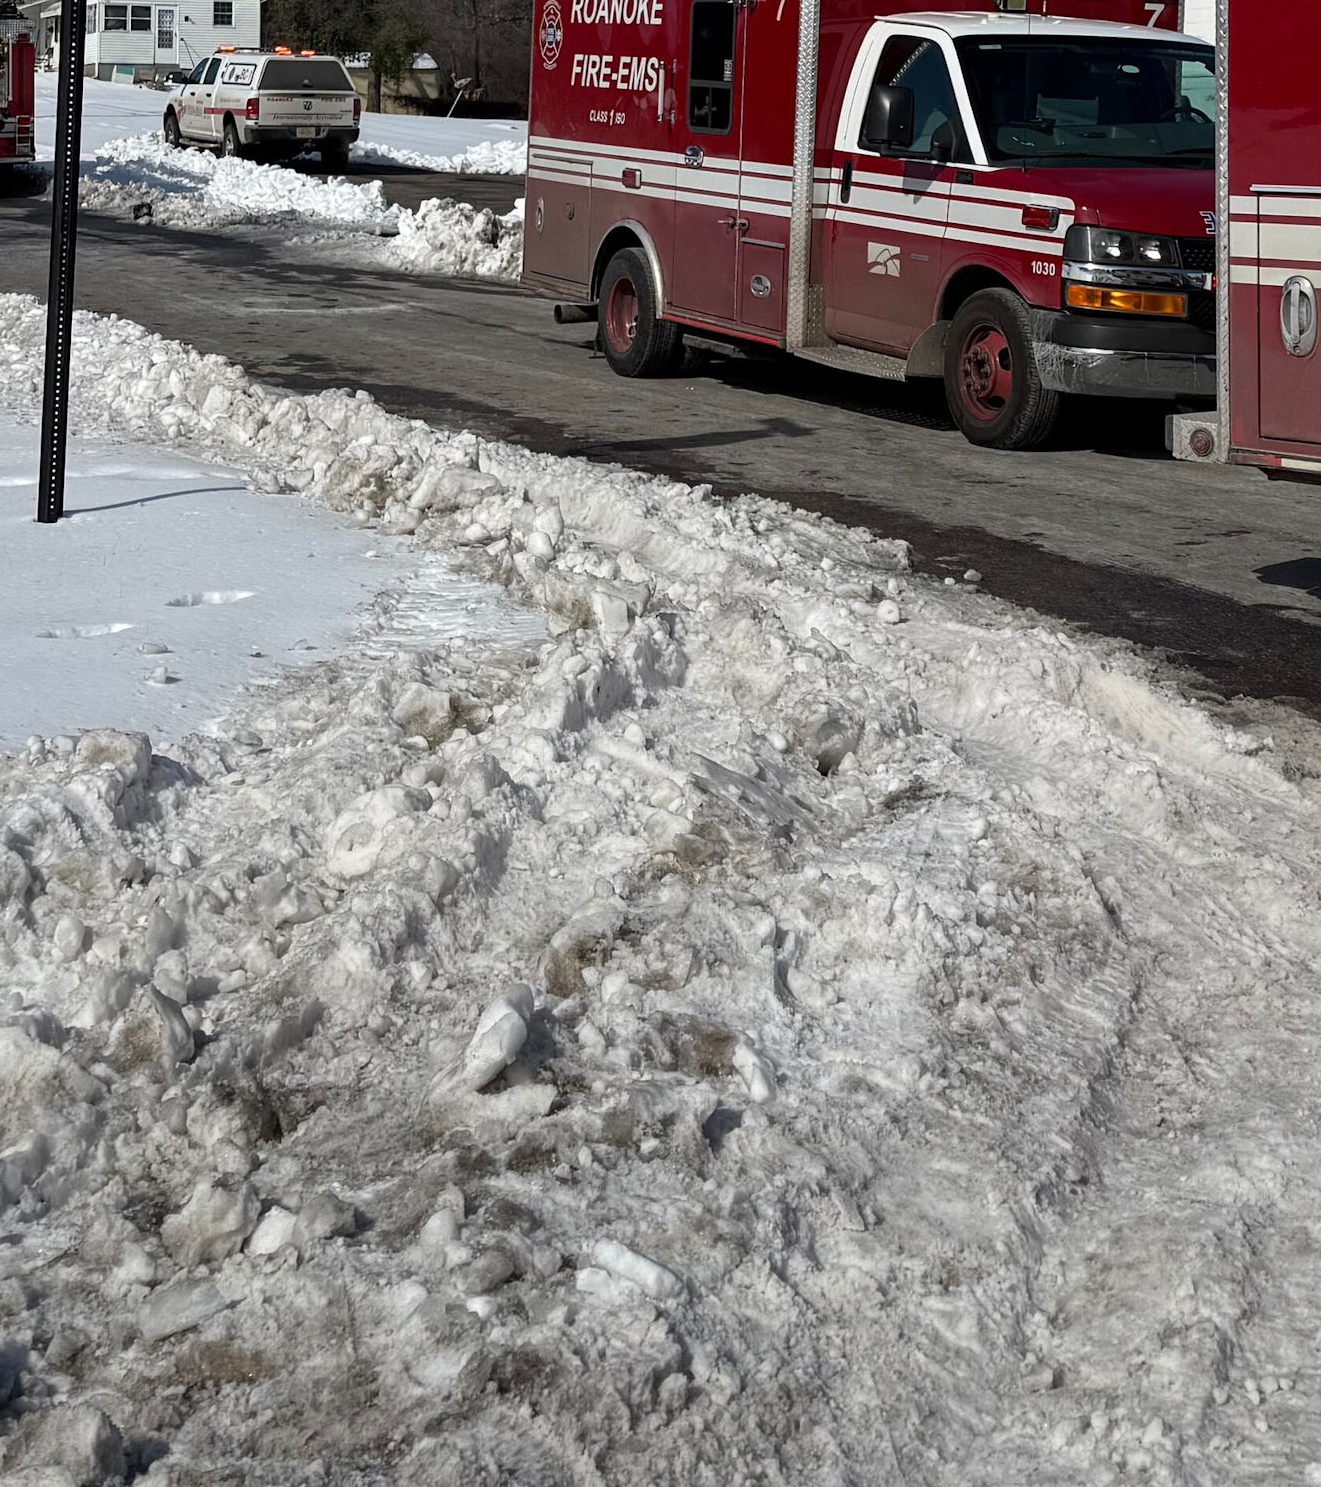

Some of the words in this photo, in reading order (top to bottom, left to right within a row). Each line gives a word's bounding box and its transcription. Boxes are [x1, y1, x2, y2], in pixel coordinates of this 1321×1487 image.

[1144, 2, 1165, 28] 7
[570, 53, 659, 92] FIRE-EMS
[609, 108, 615, 126] 1
[1031, 260, 1056, 277] 1030
